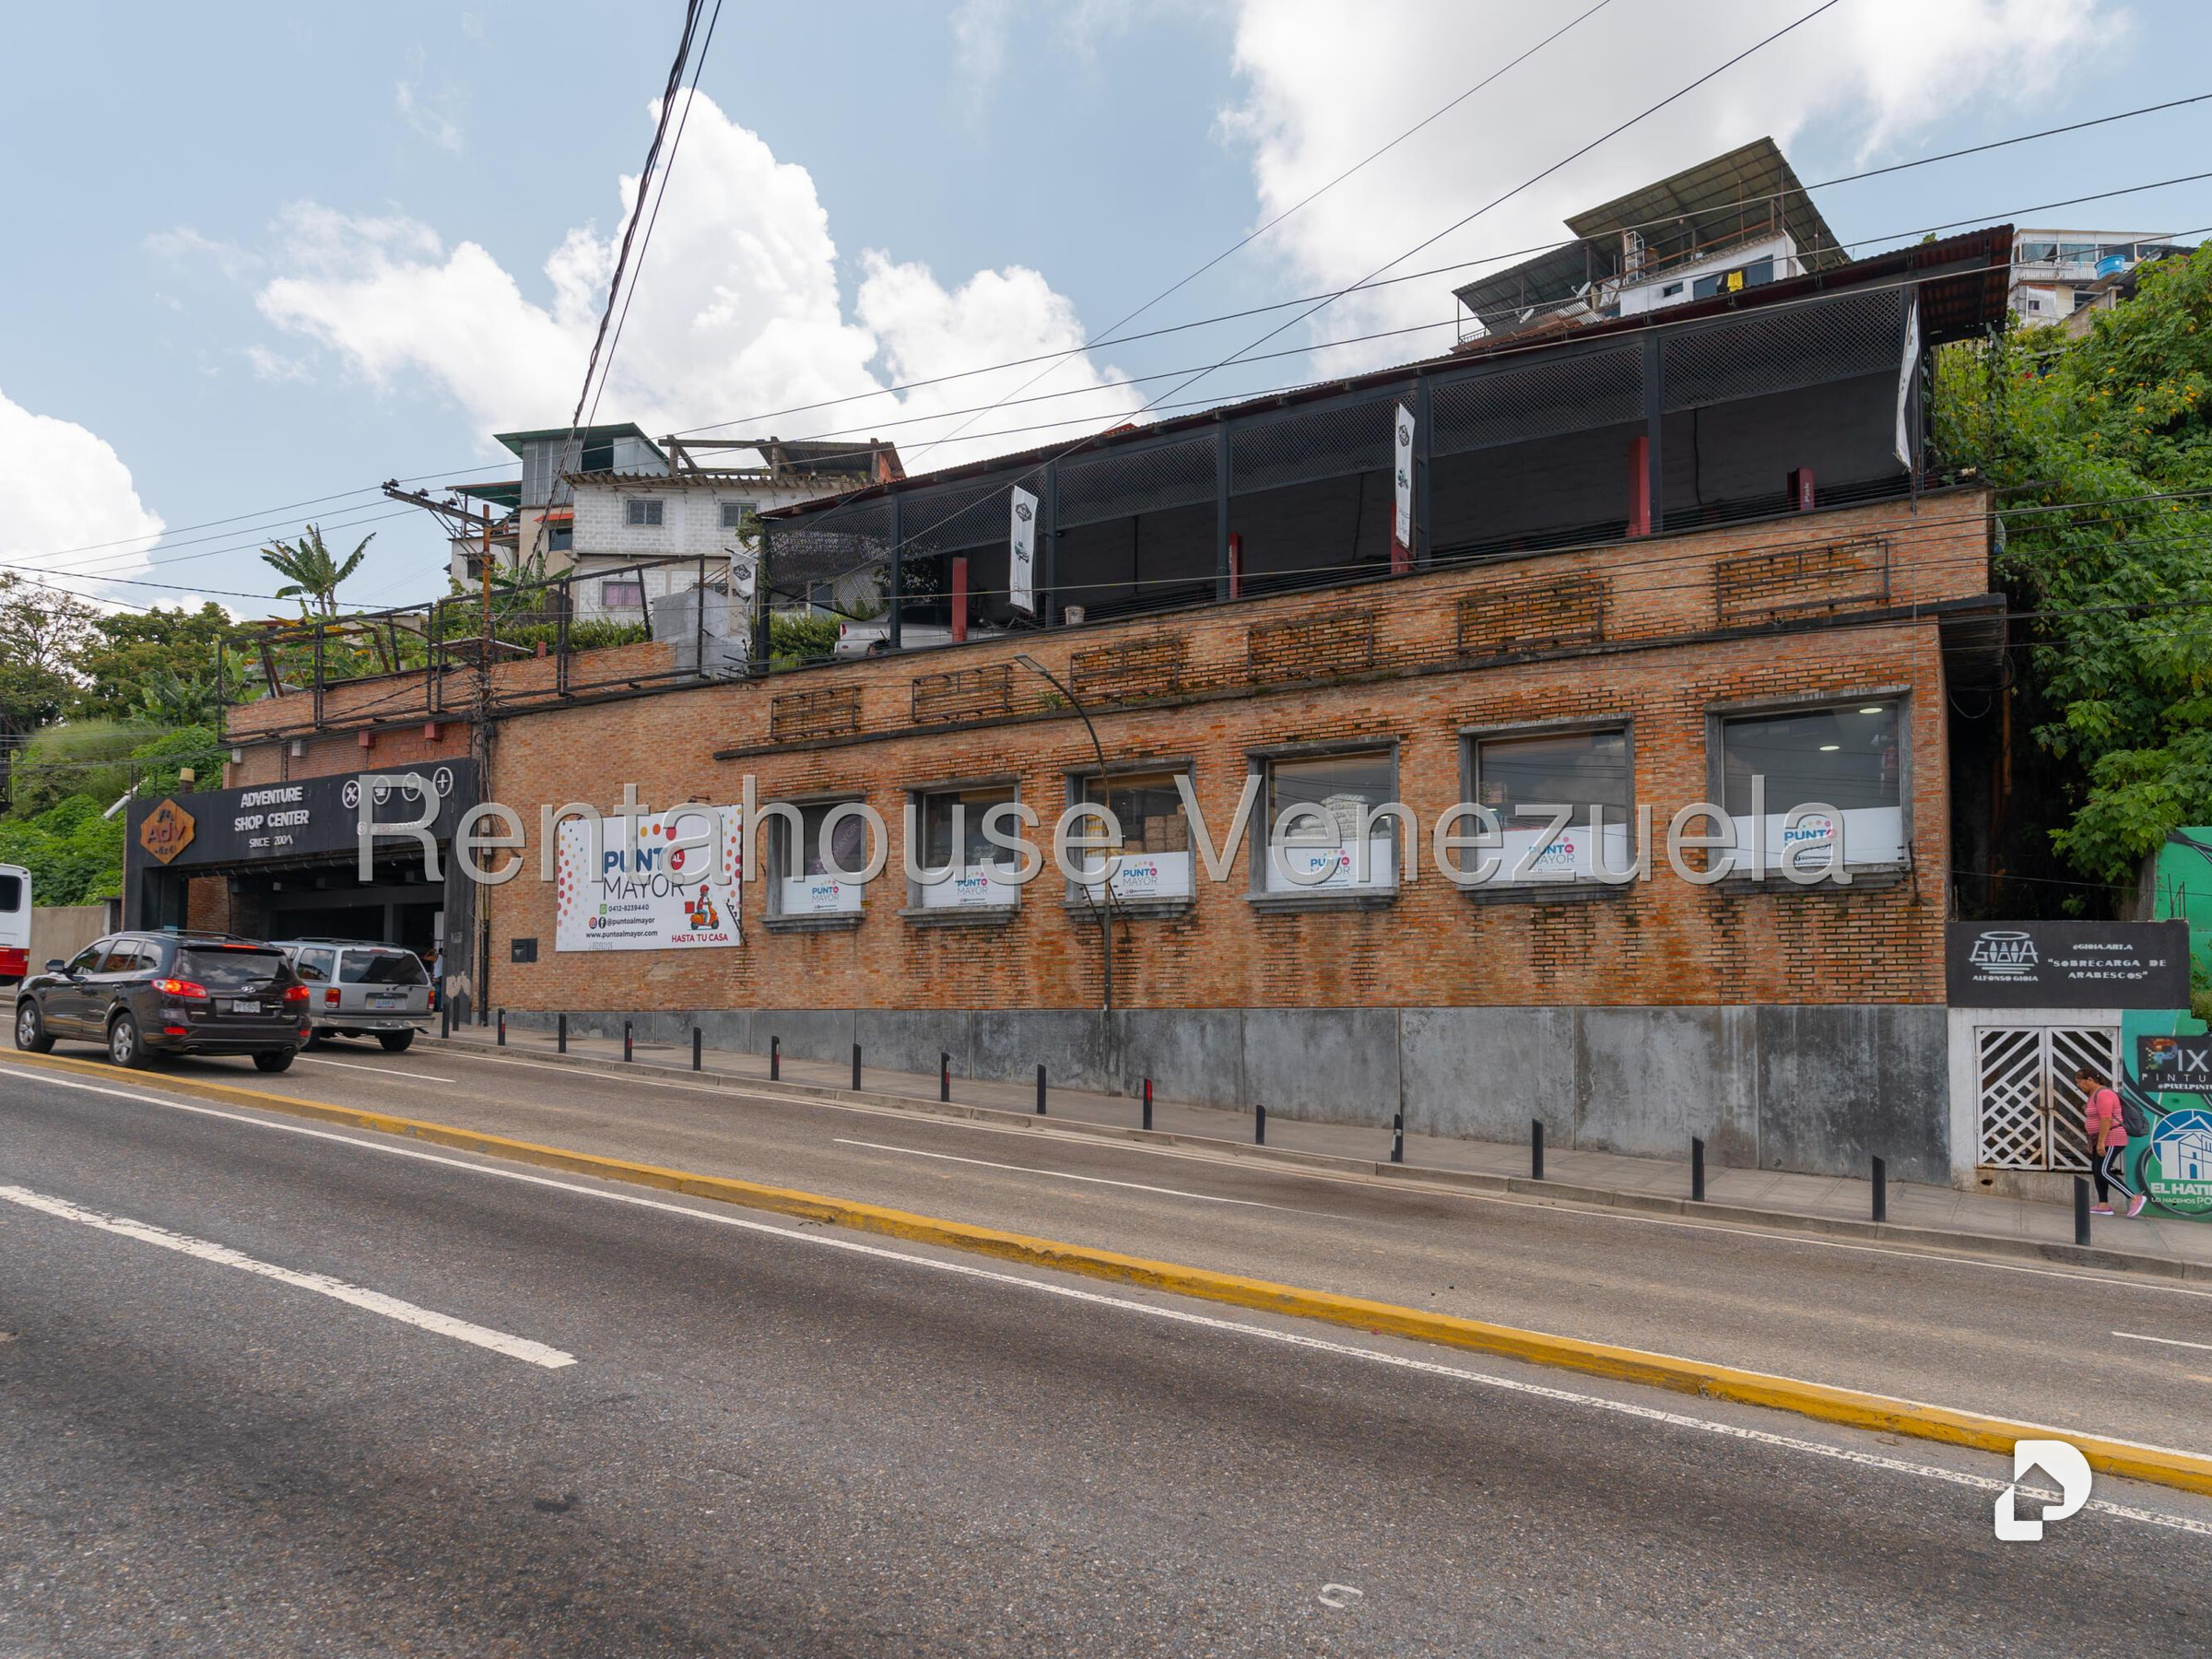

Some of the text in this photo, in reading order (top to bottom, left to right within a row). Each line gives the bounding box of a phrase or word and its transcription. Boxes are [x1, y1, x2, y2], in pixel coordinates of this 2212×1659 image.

[241, 786, 303, 808] ADVENTURE
[234, 809, 310, 832] SHOP CENTER
[249, 837, 270, 848] SINCE
[1123, 877, 1158, 886] MAYOR
[604, 873, 685, 900] MAYOR
[958, 887, 988, 895] MAYOR
[608, 903, 650, 912] 0412-8239440
[606, 917, 655, 927] @puntoalmayor
[585, 930, 658, 939] www.puntoalmayor.com
[671, 933, 728, 943] HASTA TU CASA
[2148, 959, 2167, 967] DE
[1972, 974, 2012, 982] ALFONSO
[2158, 1082, 2212, 1091] @PIXELPINT
[2150, 1182, 2171, 1194] EL
